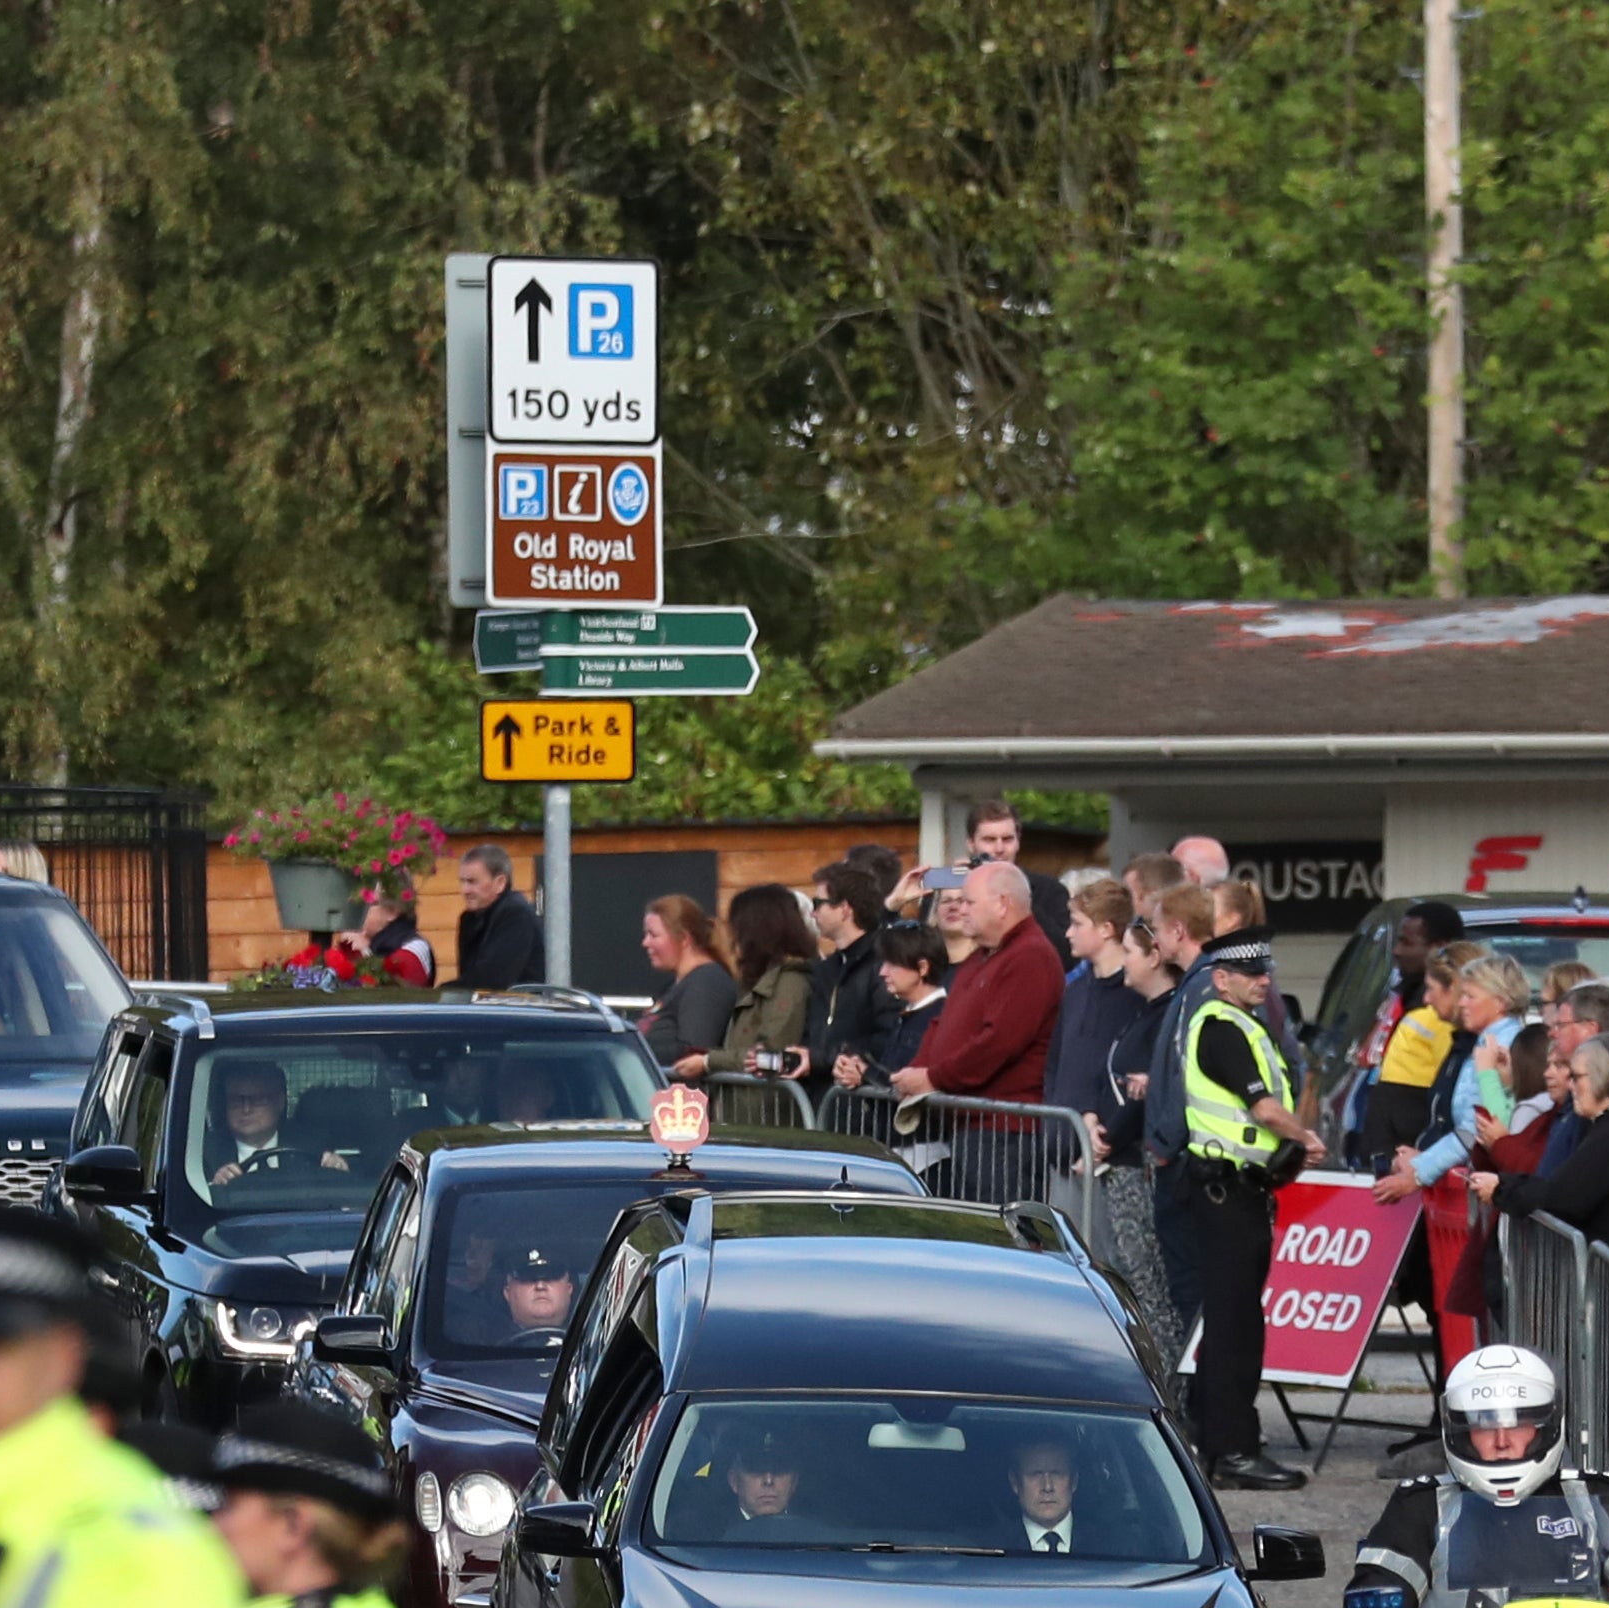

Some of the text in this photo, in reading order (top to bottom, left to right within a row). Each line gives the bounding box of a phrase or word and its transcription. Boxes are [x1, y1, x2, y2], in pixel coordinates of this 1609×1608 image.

[507, 388, 642, 428] 150 yds
[513, 531, 636, 565] Old Royal
[529, 563, 621, 591] Station
[533, 715, 621, 736] Park &
[548, 744, 607, 766] Ride
[1276, 1222, 1372, 1268] ROAD
[1260, 1287, 1363, 1333] LOSED
[1471, 1386, 1528, 1400] POLICE
[1541, 1519, 1573, 1535] PICE
